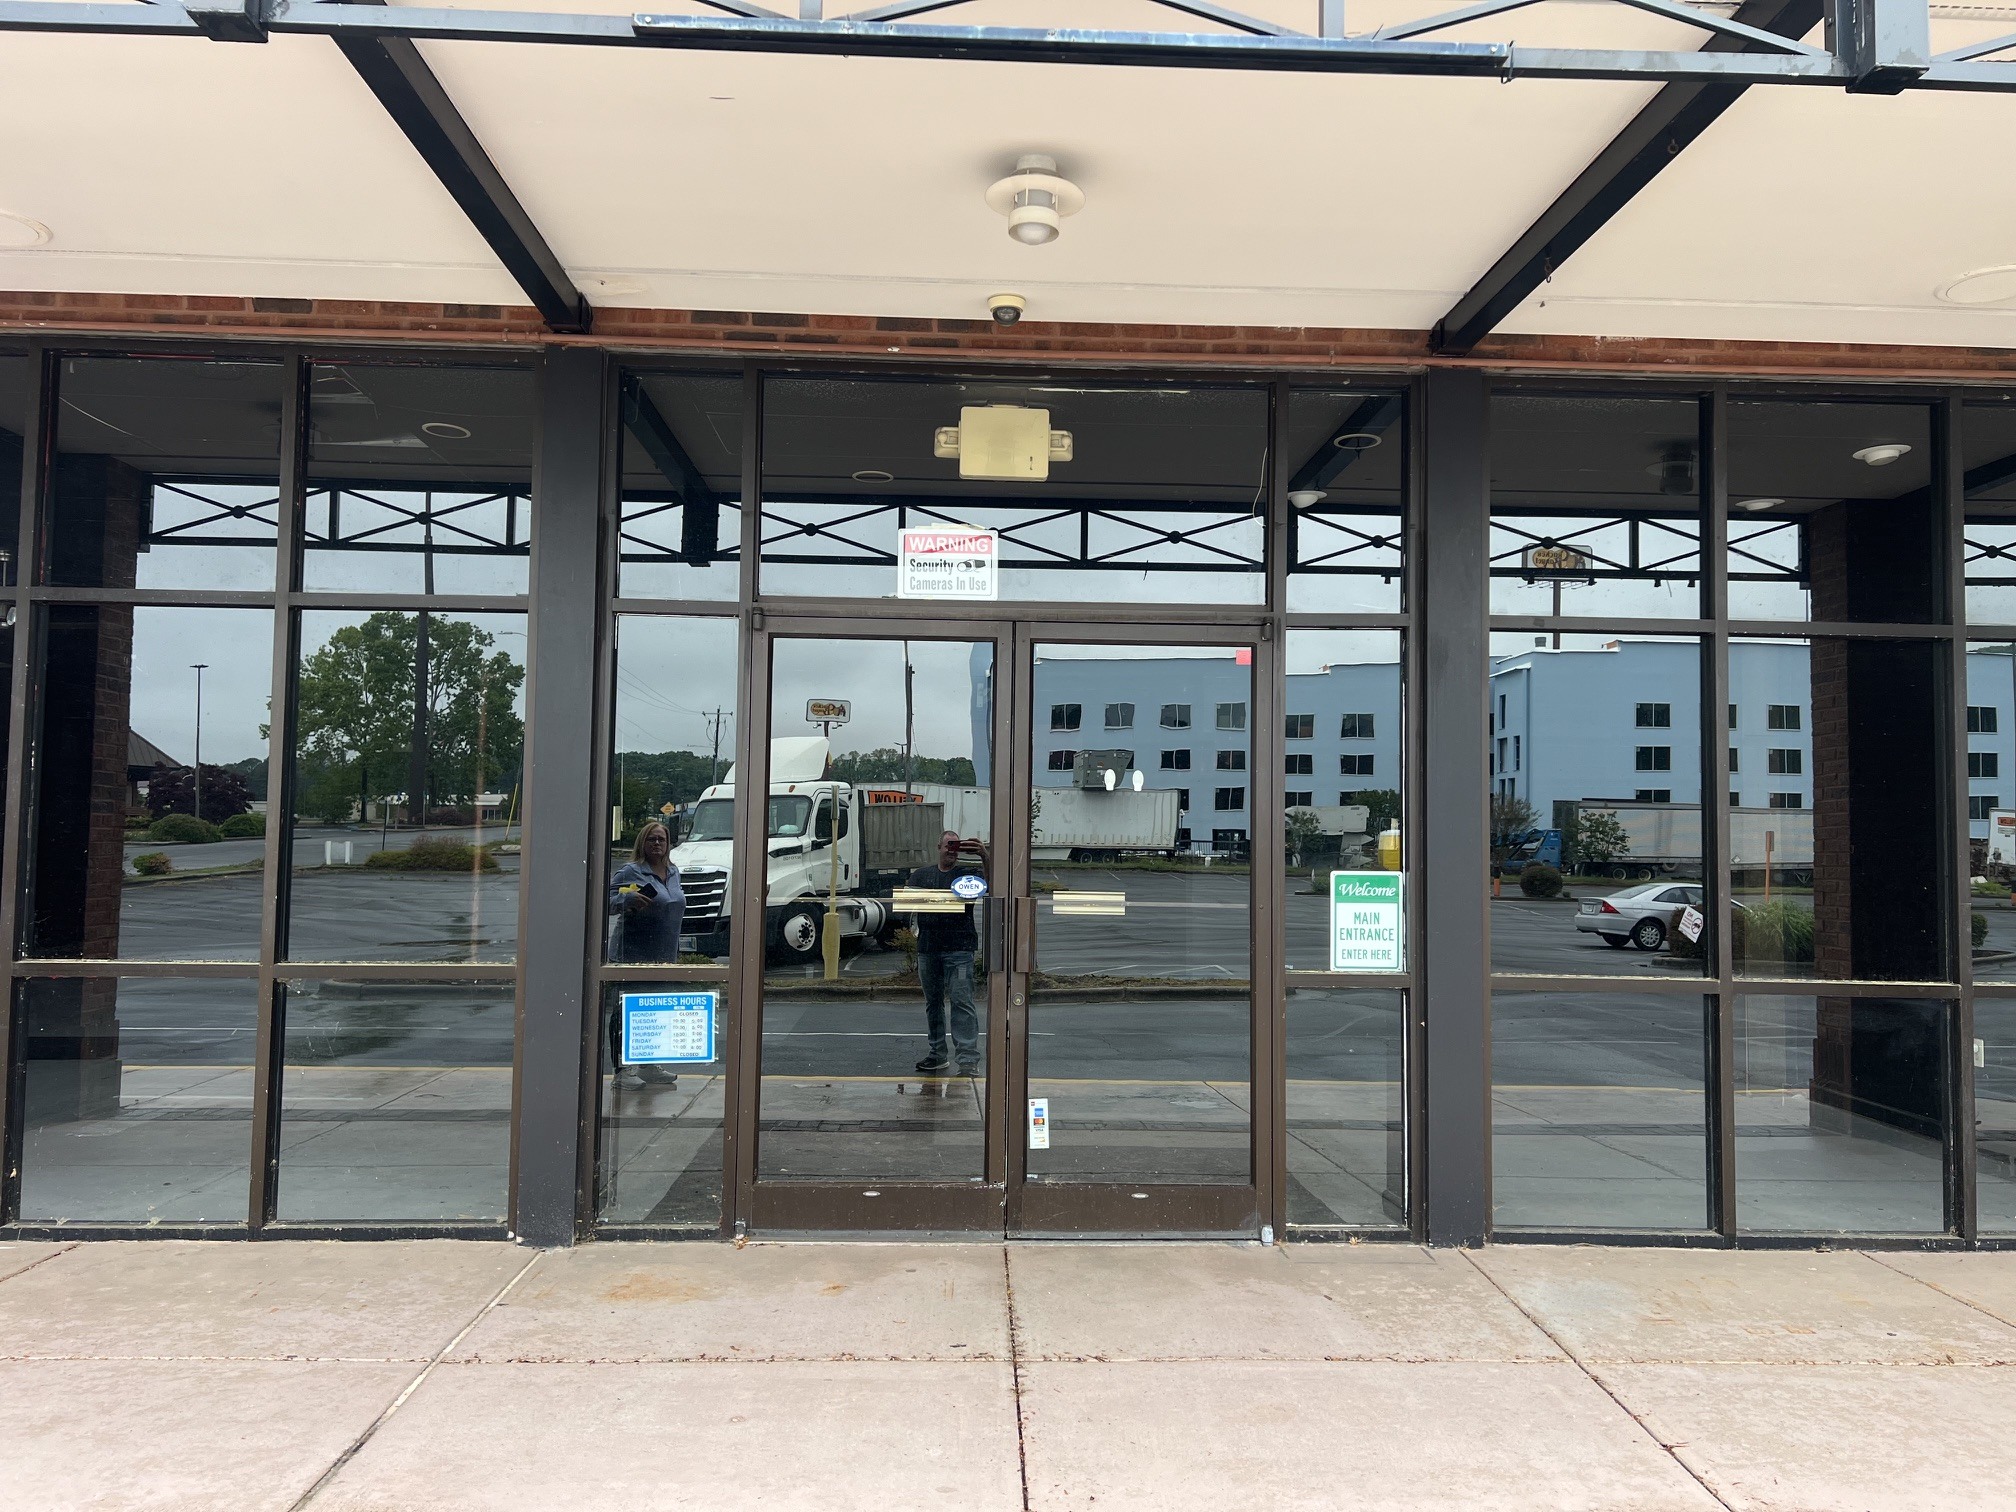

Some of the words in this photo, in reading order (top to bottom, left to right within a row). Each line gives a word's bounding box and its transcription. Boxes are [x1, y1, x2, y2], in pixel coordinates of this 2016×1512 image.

[908, 536, 989, 553] WARNING
[909, 558, 953, 575] Security
[910, 576, 953, 590] Cameras
[956, 577, 966, 590] In
[969, 577, 987, 590] Use
[1338, 882, 1396, 897] Welcome
[1353, 912, 1380, 925] MAIN
[1340, 928, 1394, 941] ENTRANCE
[1341, 949, 1367, 960] ENTER
[1370, 949, 1392, 960] HERE
[638, 997, 678, 1006] BUSINESS
[680, 997, 707, 1005] HOURS
